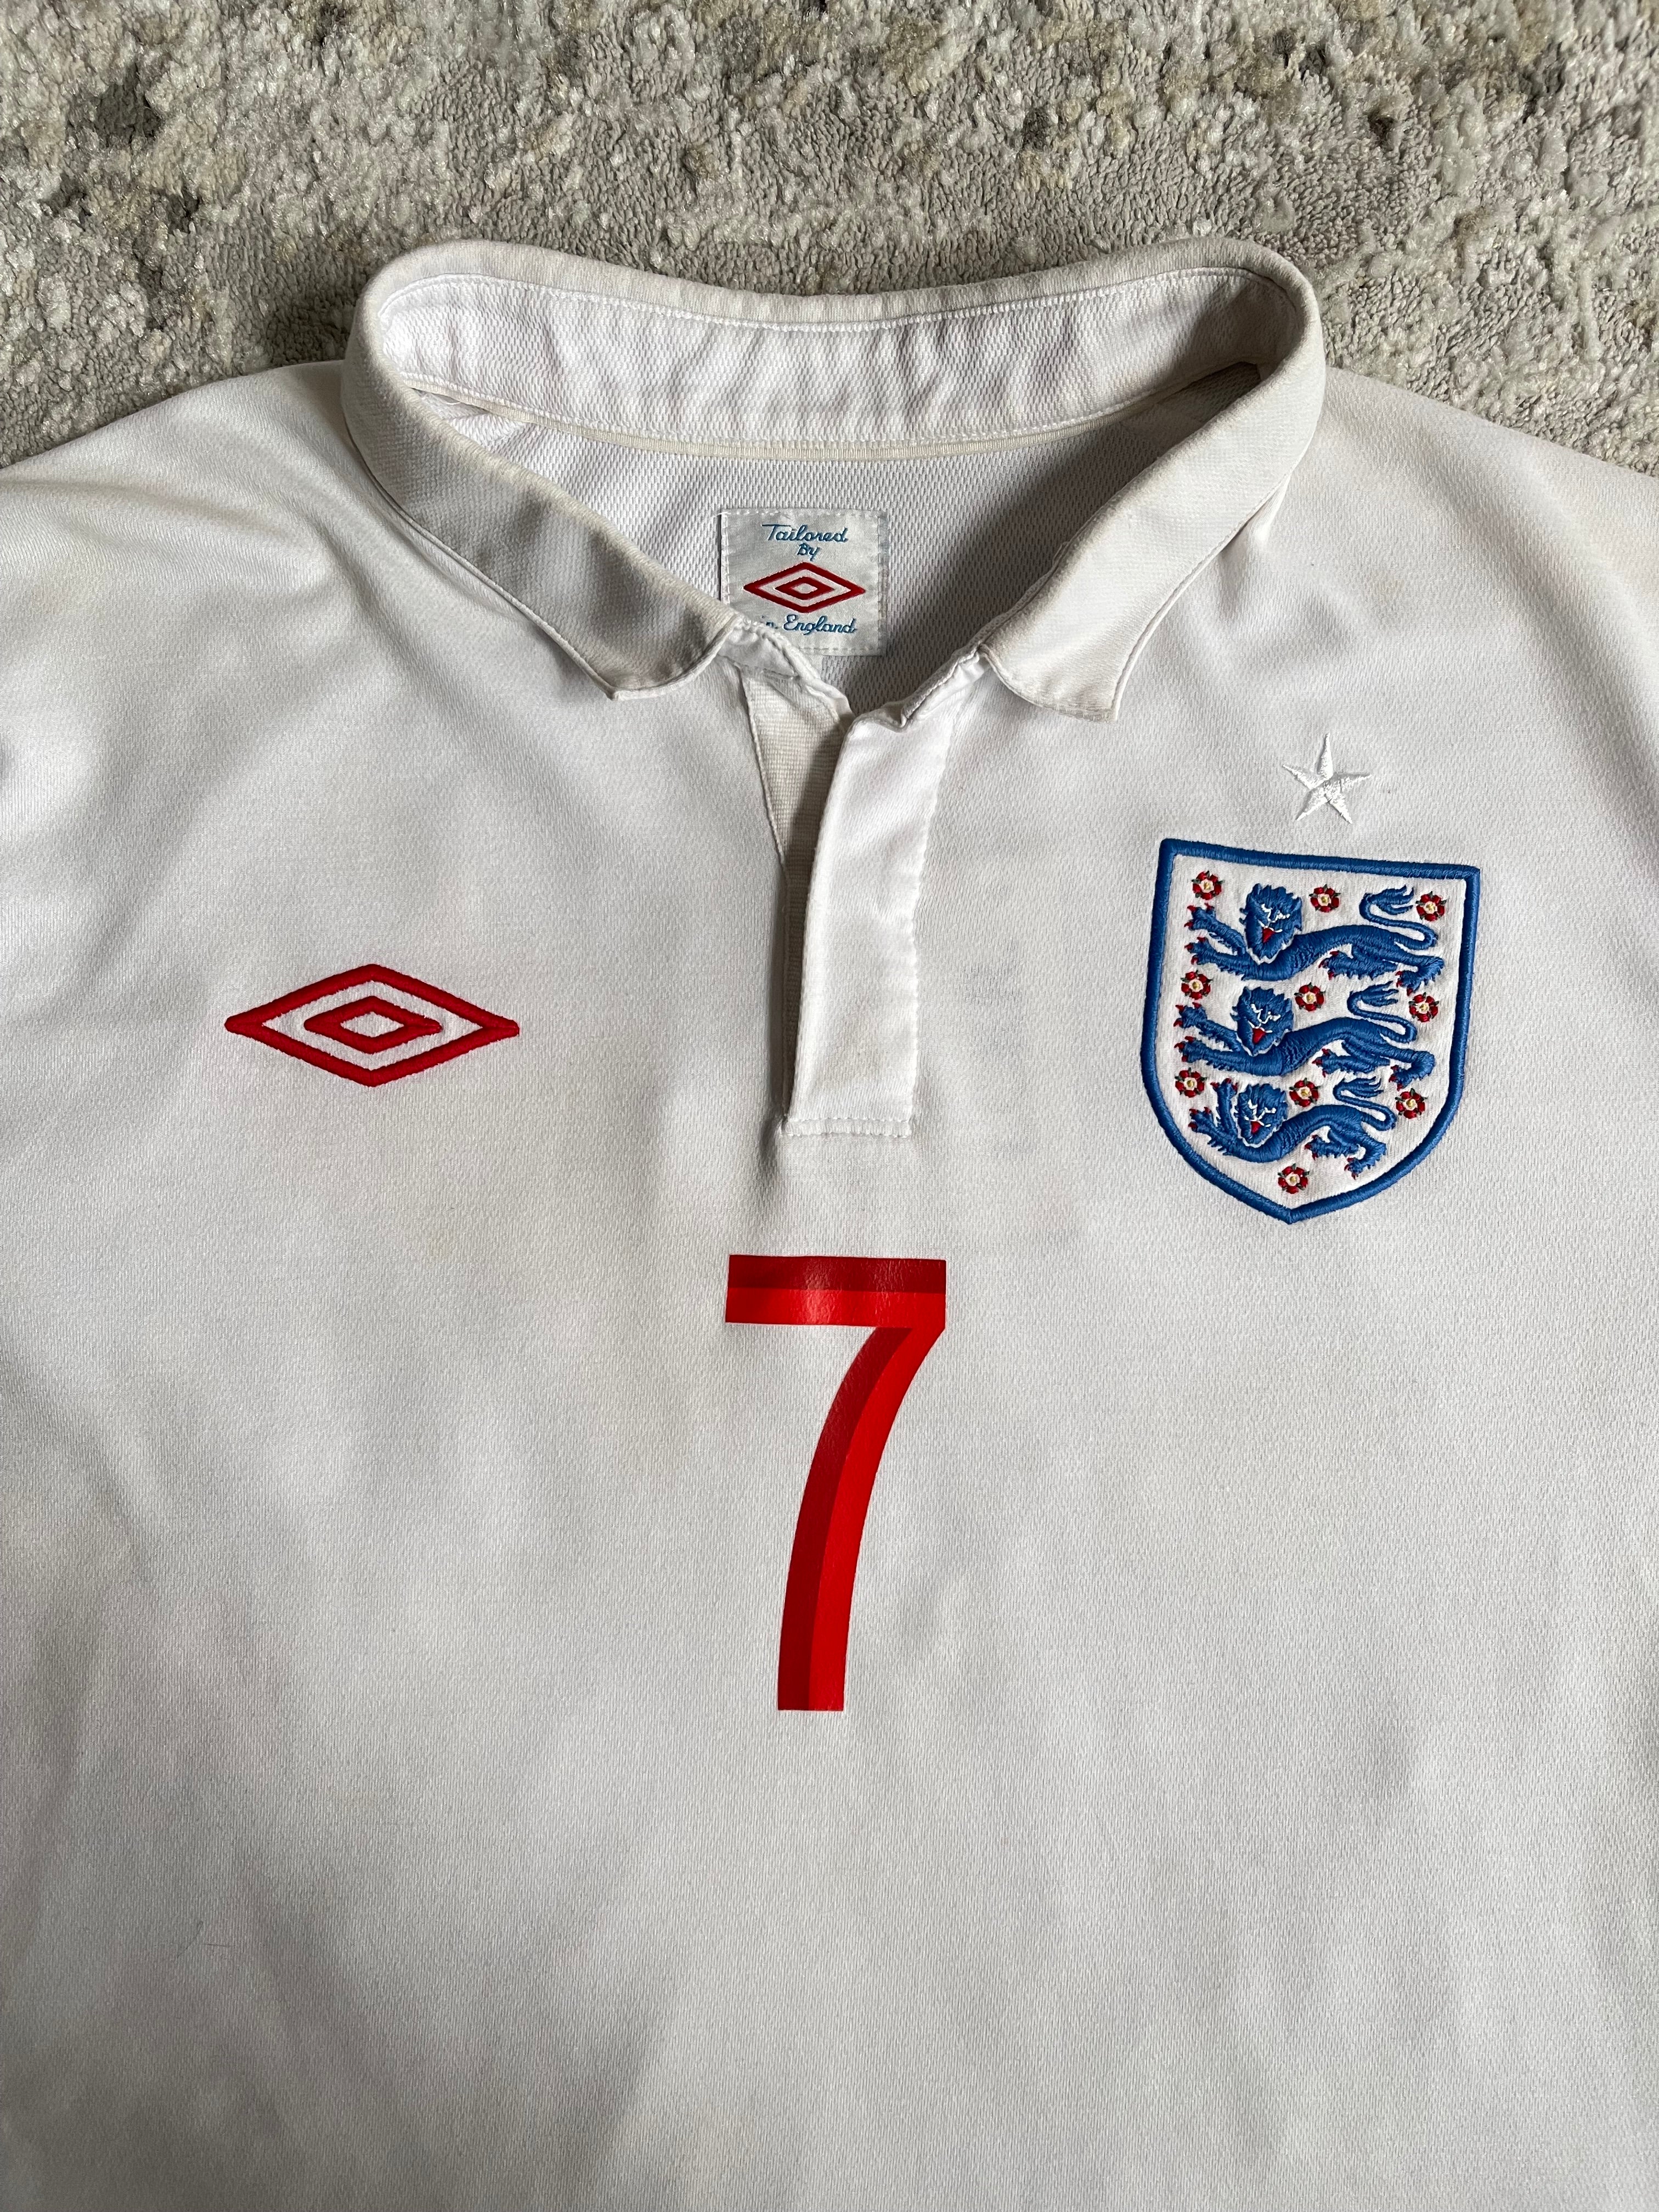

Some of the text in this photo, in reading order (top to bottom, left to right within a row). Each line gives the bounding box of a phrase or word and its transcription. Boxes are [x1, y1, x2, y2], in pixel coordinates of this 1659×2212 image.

[761, 524, 849, 543] Tailored
[797, 542, 820, 562] By
[783, 614, 857, 636] England
[725, 1254, 946, 1712] 7
